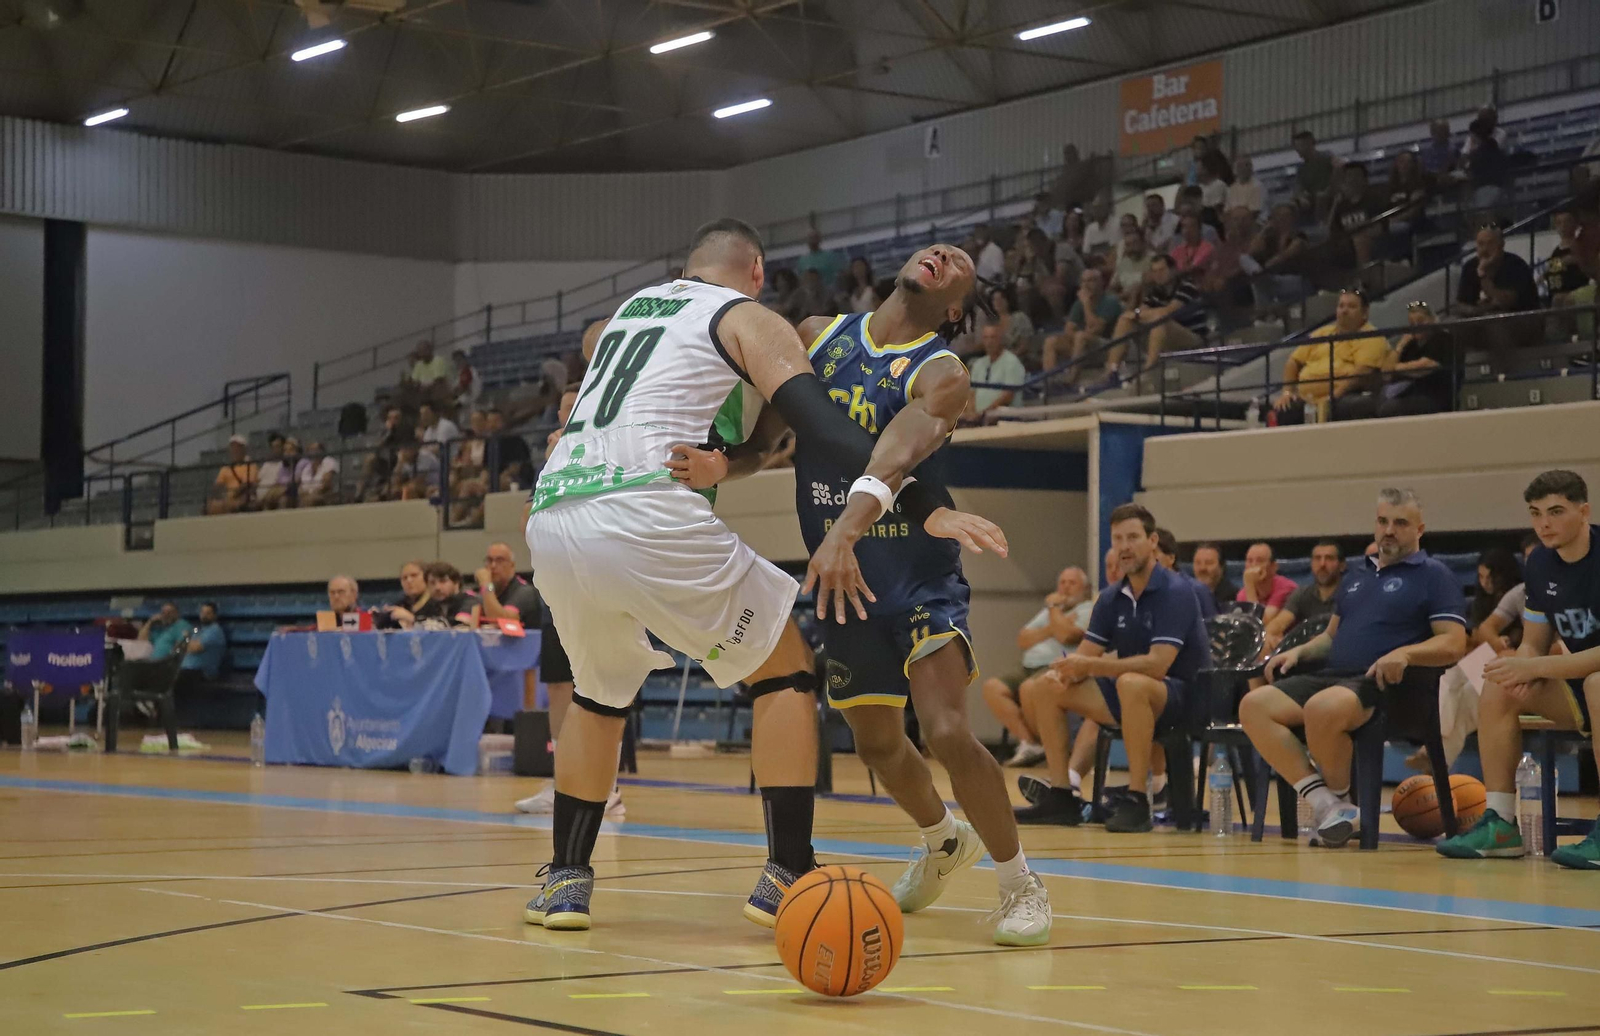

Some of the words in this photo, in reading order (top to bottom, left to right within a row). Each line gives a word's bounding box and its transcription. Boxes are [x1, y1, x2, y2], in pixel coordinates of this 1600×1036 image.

[1152, 74, 1190, 99] Bar
[559, 326, 666, 438] 28
[909, 611, 930, 623] vive
[47, 651, 92, 667] molten
